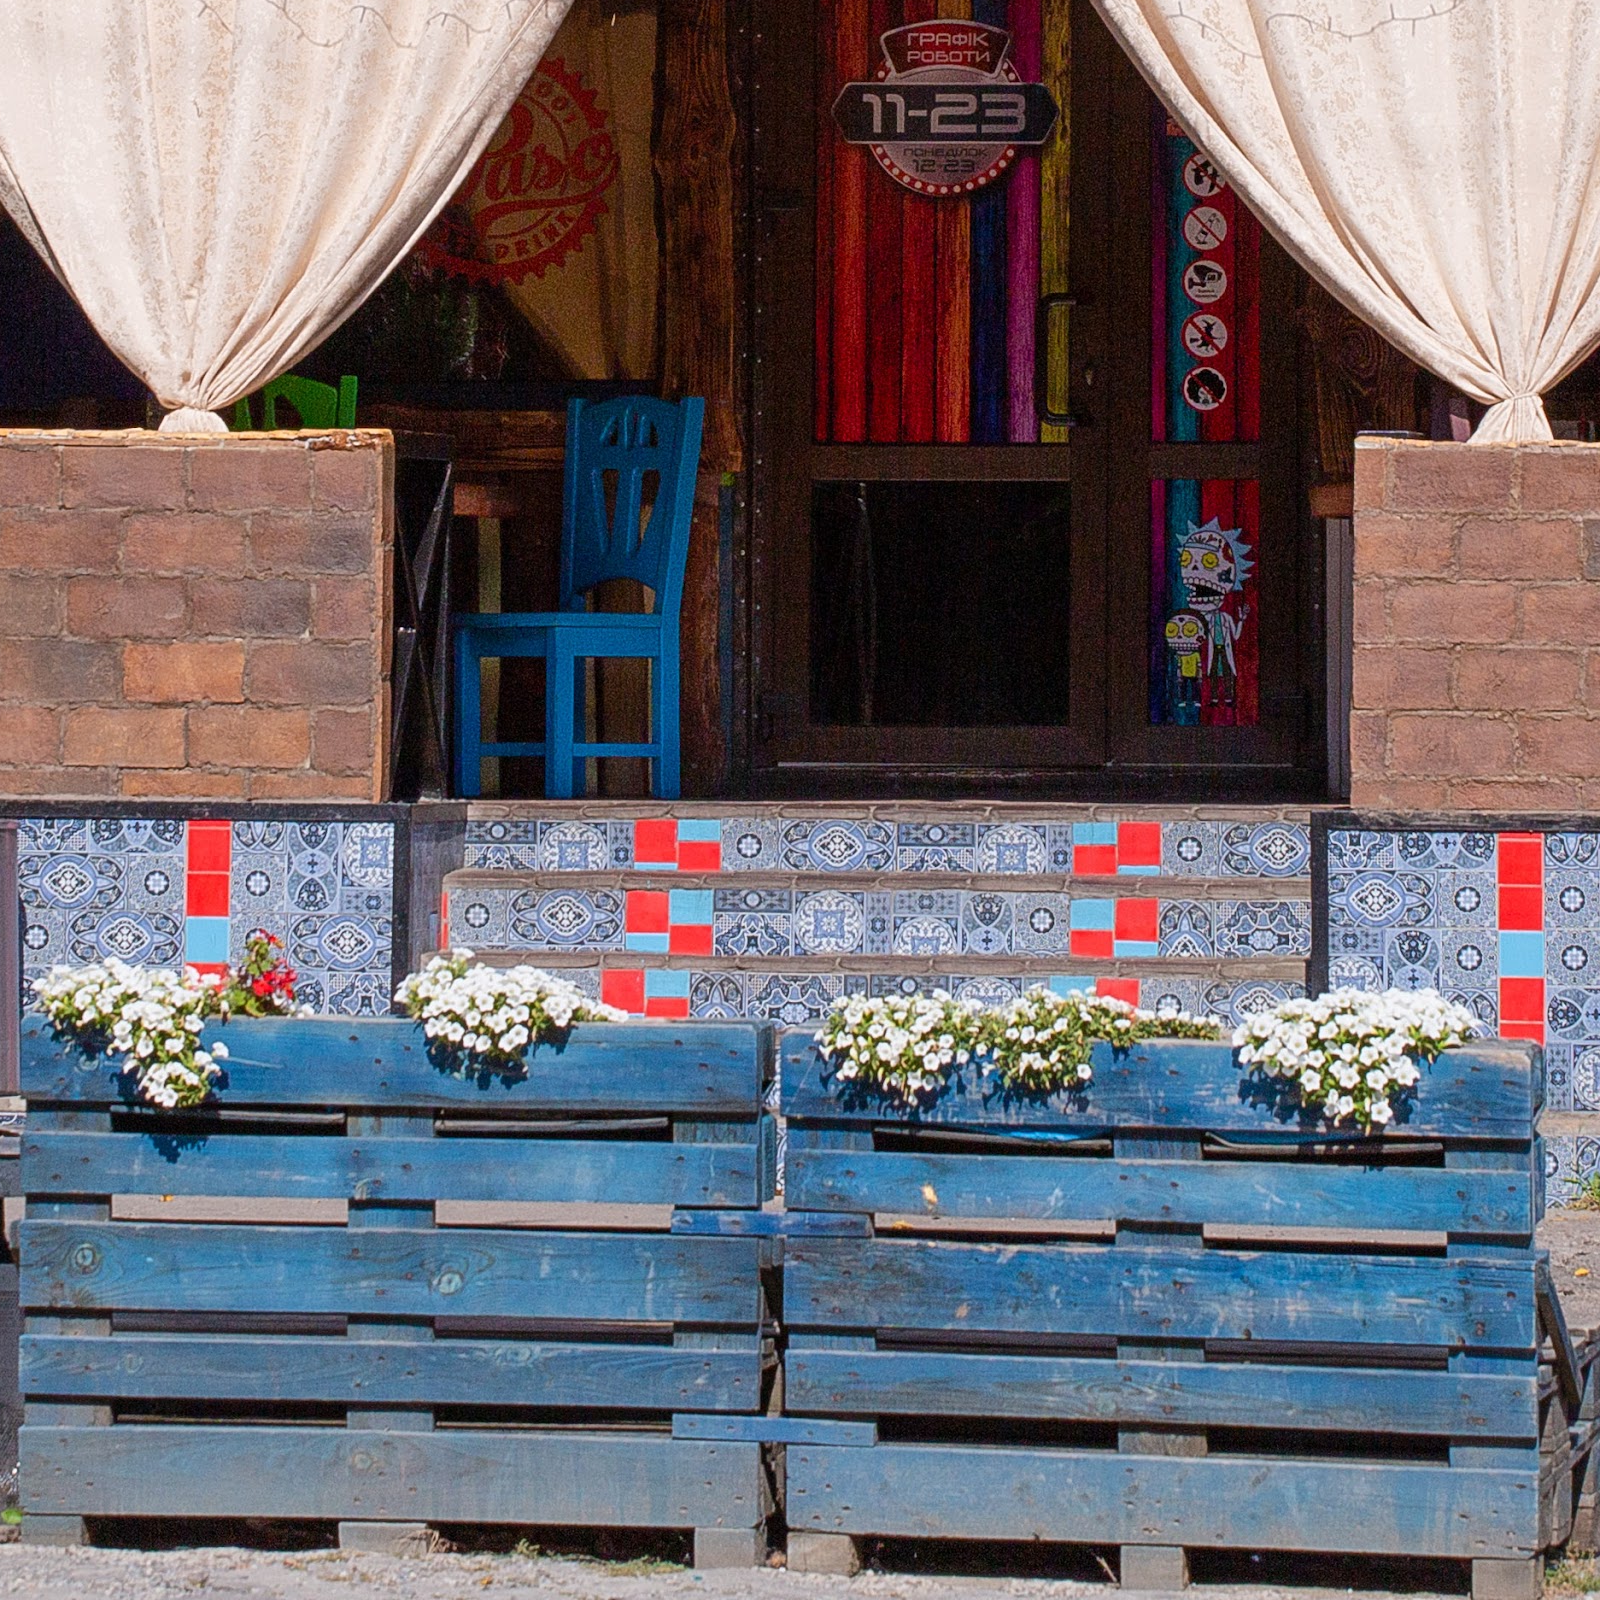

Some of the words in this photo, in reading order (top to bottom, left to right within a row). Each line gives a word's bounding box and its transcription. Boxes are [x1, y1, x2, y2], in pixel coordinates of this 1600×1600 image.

[906, 32, 990, 47] ГРАФІК
[906, 50, 991, 63] РОБОТИ
[862, 92, 1026, 134] 11-23
[494, 210, 576, 260] DRINK
